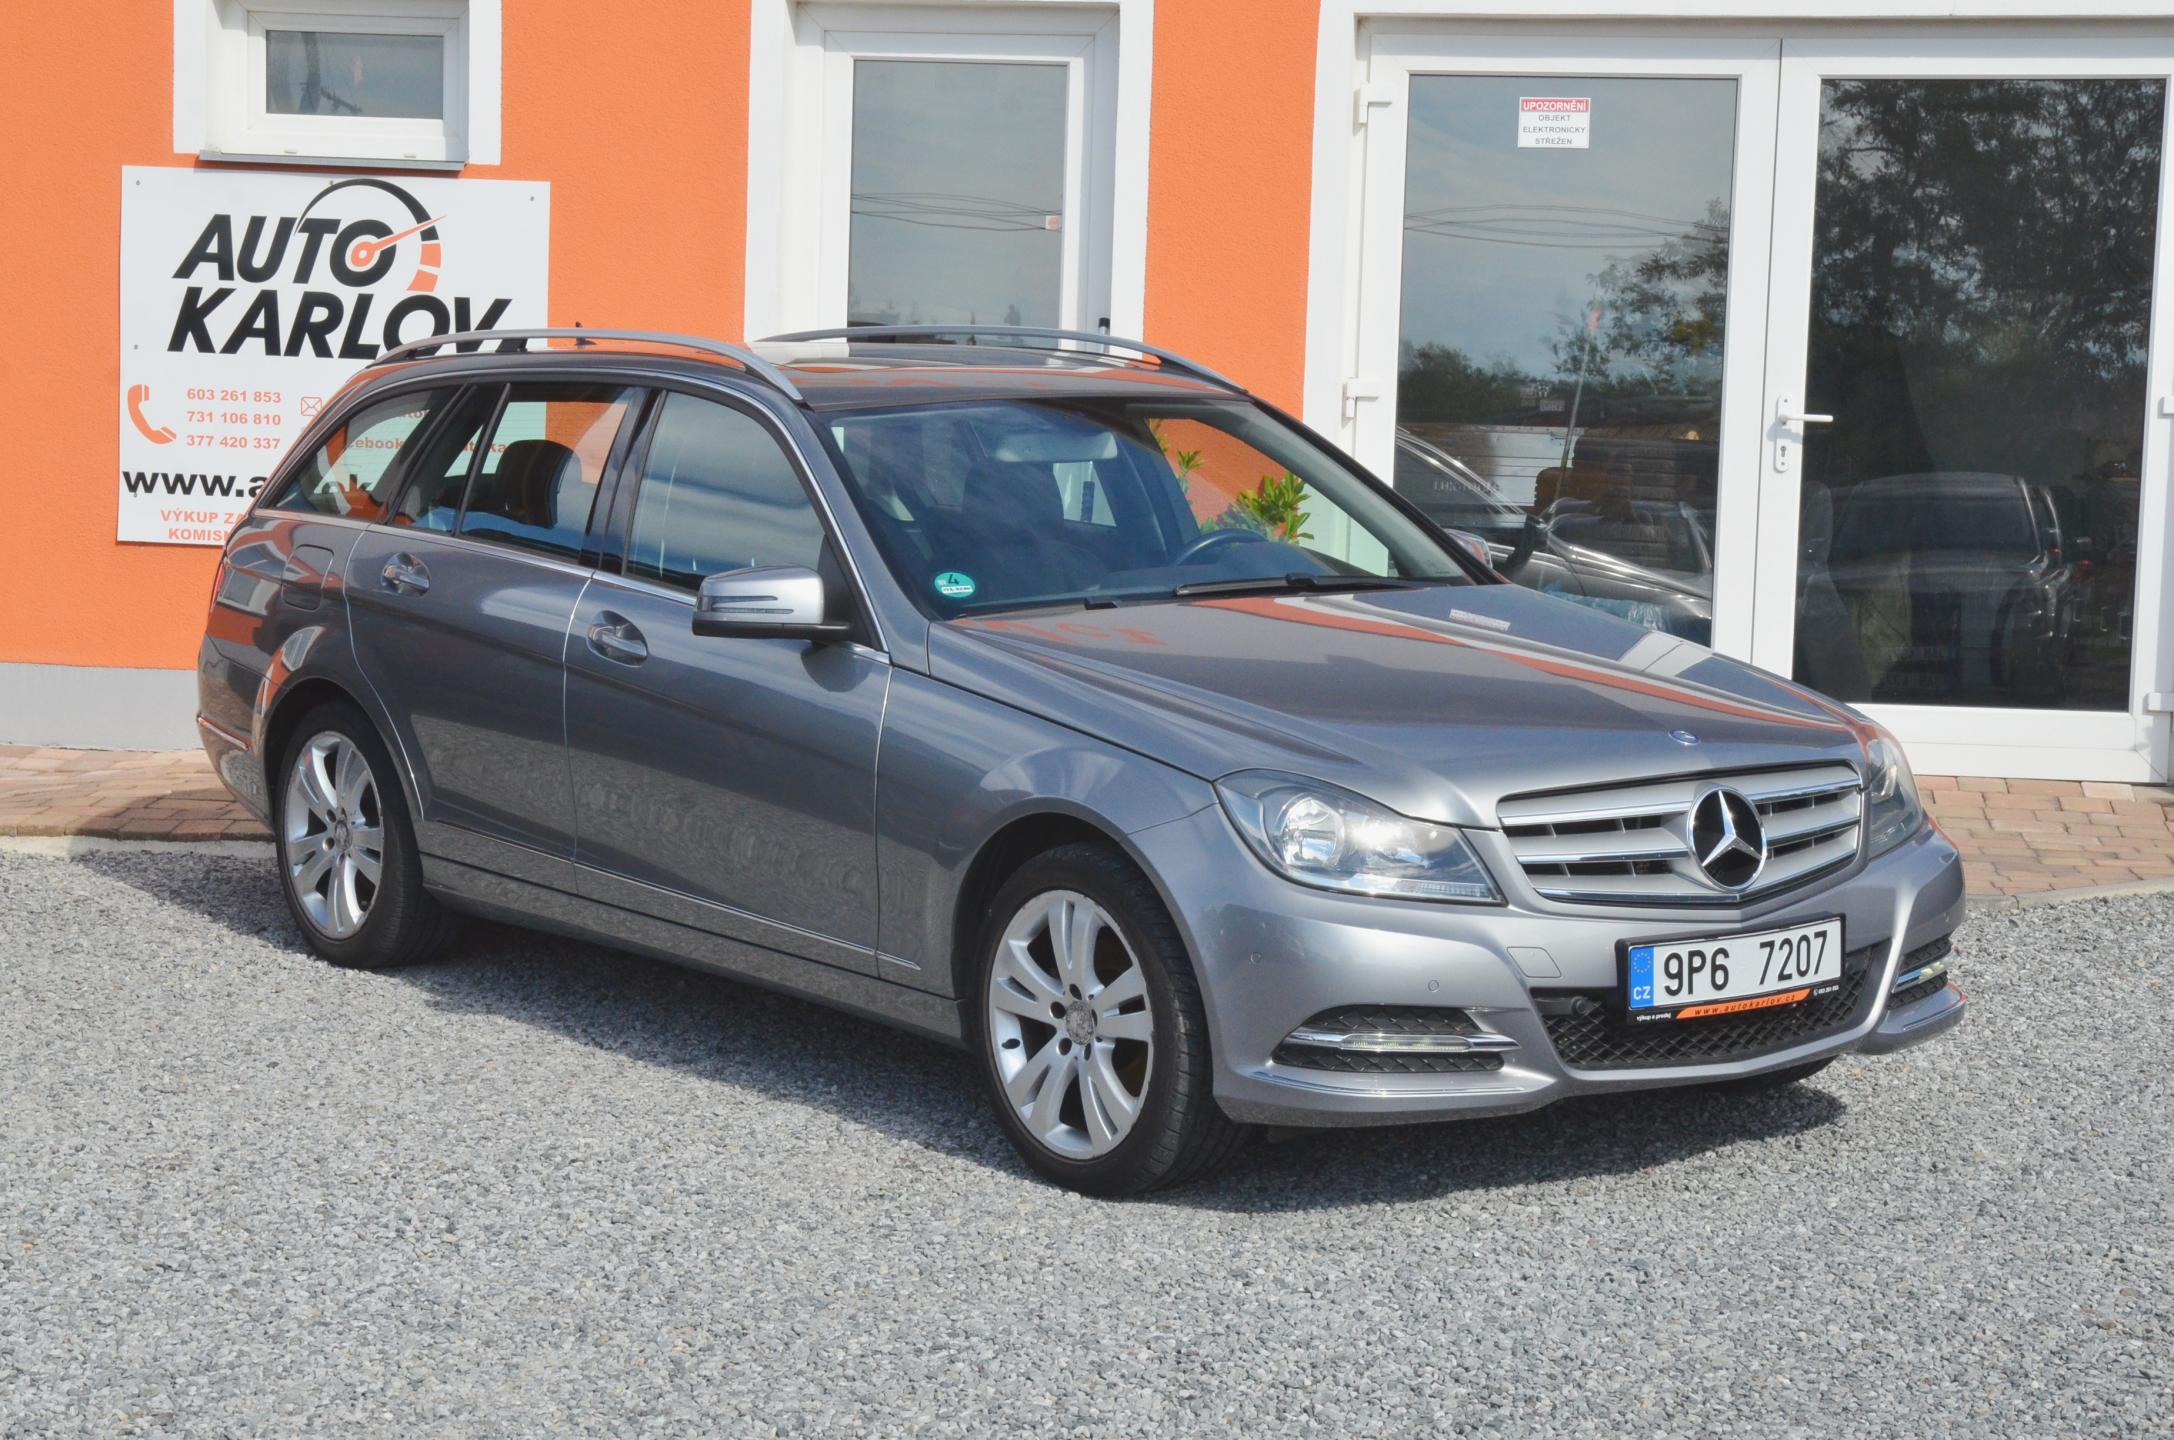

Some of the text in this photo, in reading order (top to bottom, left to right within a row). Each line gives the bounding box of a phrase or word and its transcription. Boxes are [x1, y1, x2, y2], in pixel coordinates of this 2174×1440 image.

[1538, 114, 1571, 122] OBJEKT
[172, 213, 397, 287] AUTO
[167, 286, 512, 361] KARLOV
[187, 388, 281, 403] 603 261 853
[187, 411, 281, 426] 731 106 810
[186, 434, 280, 449] 377 420 337
[122, 471, 268, 498] www.a
[161, 507, 218, 524] VÝKUP
[1664, 930, 1828, 997] 9P6 7207
[1633, 985, 1651, 1000] CZ
